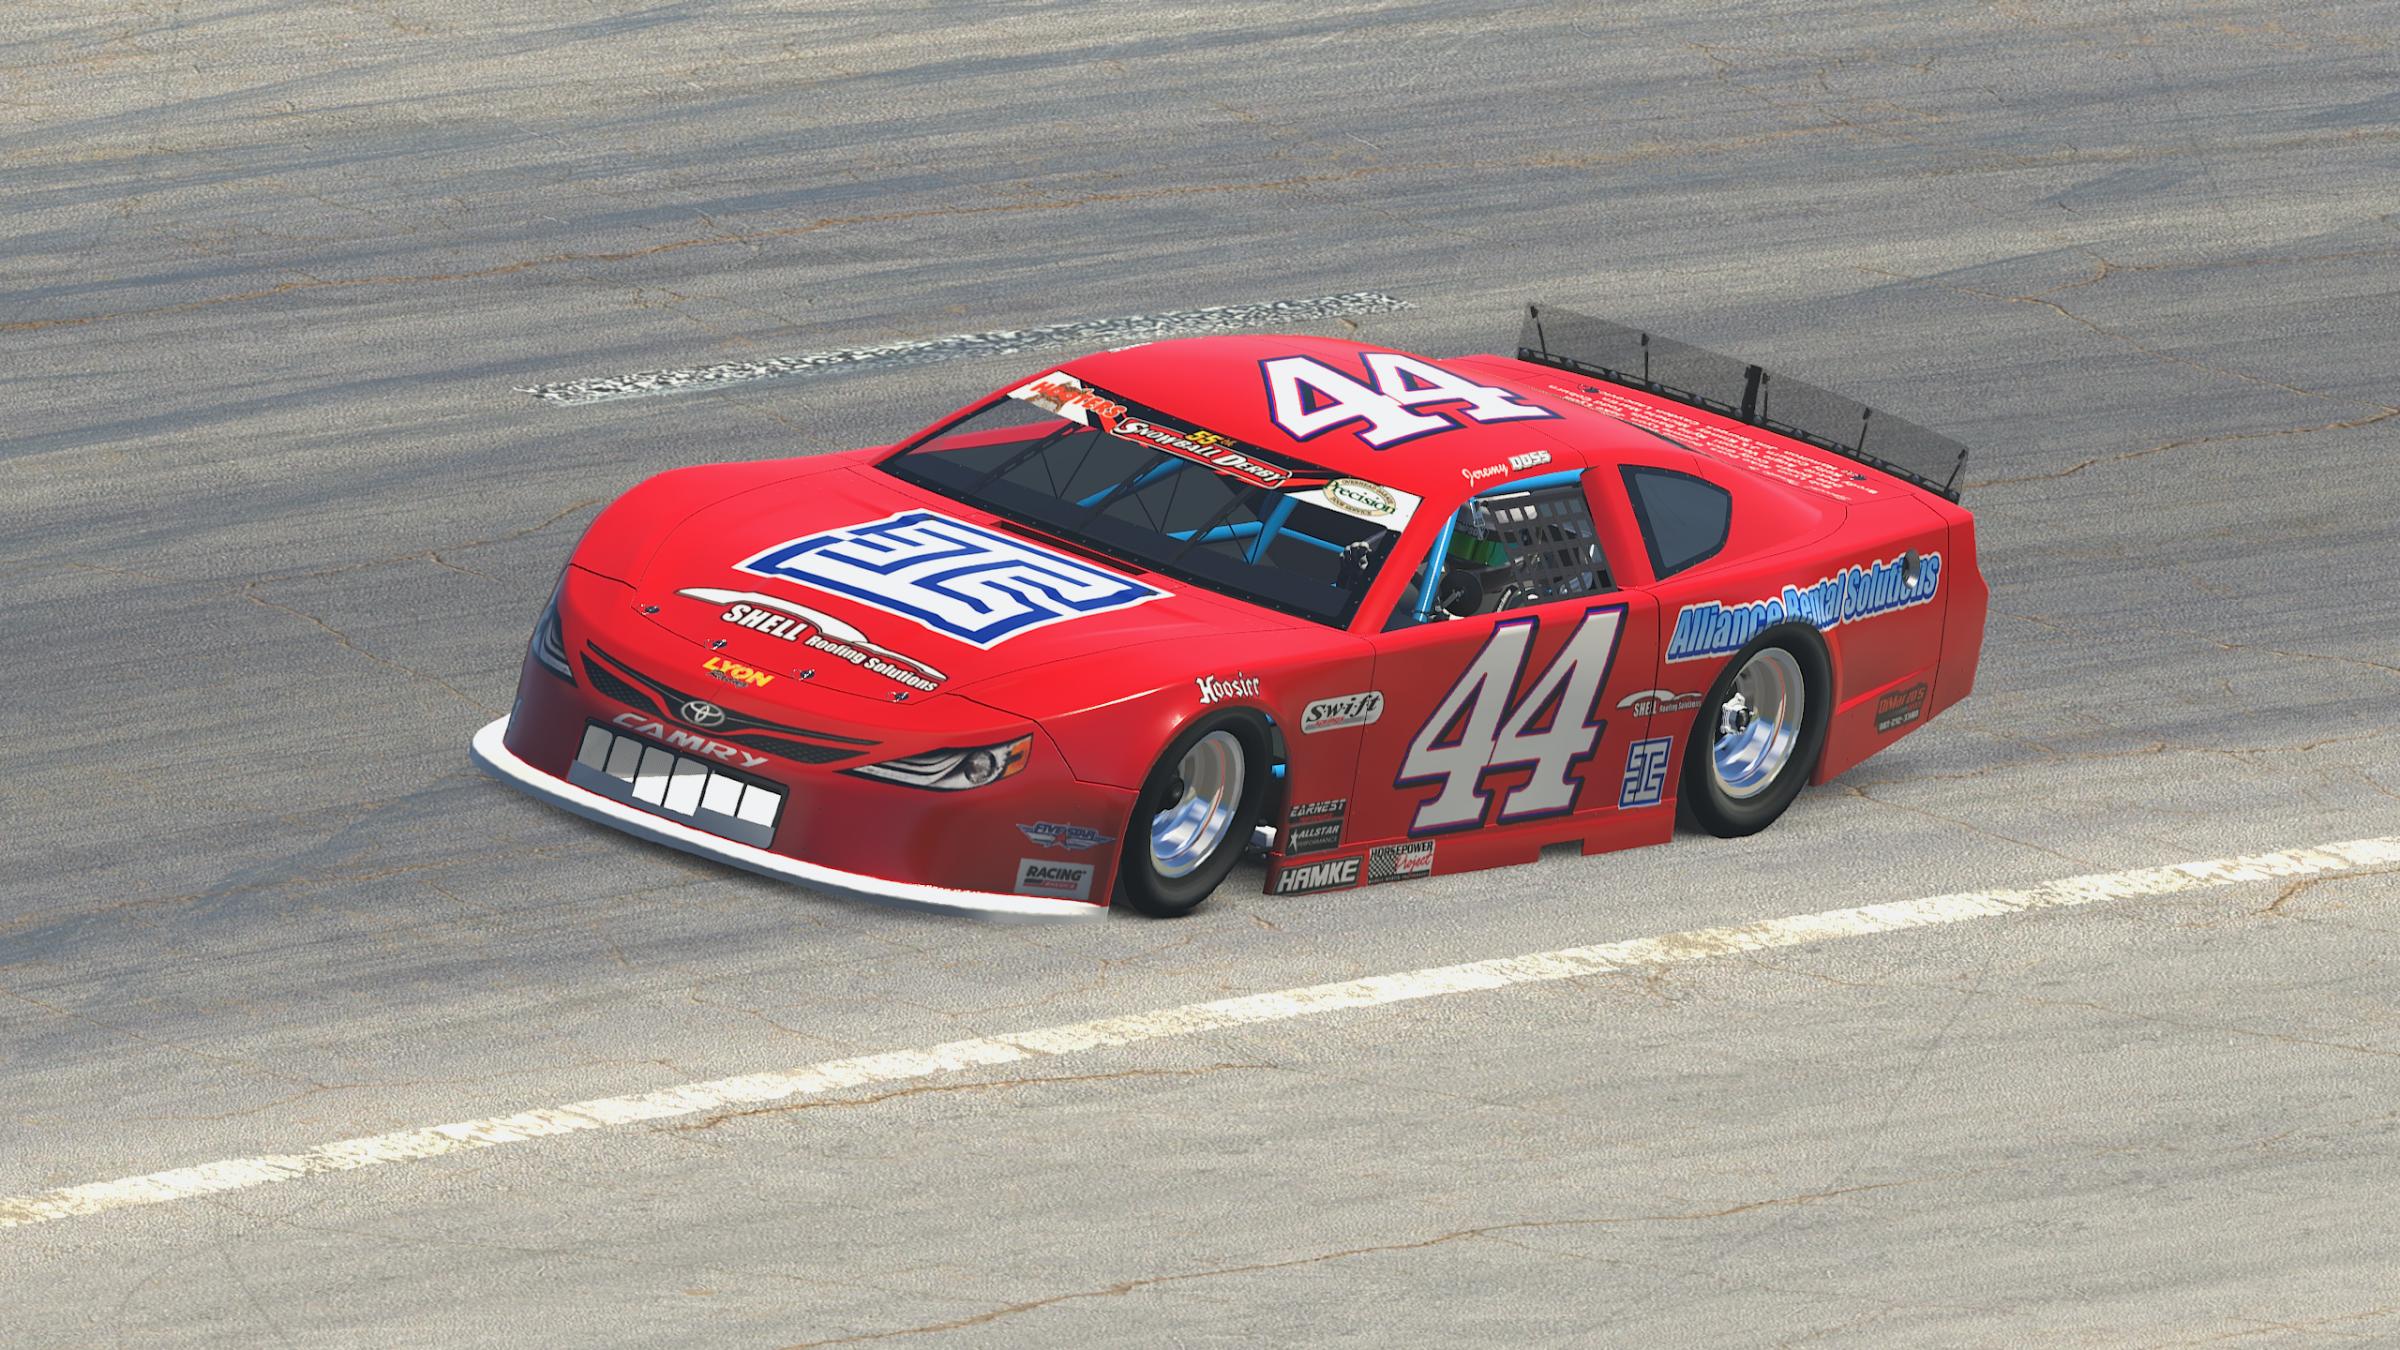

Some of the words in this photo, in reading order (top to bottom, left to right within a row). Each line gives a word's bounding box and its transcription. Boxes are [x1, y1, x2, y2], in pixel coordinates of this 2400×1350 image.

[1030, 381, 1127, 418] HOOTERS
[1258, 353, 1565, 451] 44
[1113, 421, 1214, 459] SNOWBALL
[1211, 453, 1287, 483] DERBY
[1461, 463, 1508, 488] Jeremy
[1508, 450, 1552, 472] DOSS
[1323, 480, 1396, 515] Precision
[1843, 552, 1942, 624] Solutins
[721, 603, 808, 642] SHELL
[804, 634, 868, 666] Roofing
[863, 656, 939, 693] Solutions
[702, 656, 775, 688] LYON
[1196, 672, 1260, 704] Hoosier
[1394, 602, 1629, 838] 44
[612, 712, 769, 768] CAMRY
[1289, 799, 1346, 818] EARNEST
[1298, 825, 1340, 840] ALLSTAR
[1371, 841, 1433, 858] HORSEPOWER
[1026, 866, 1082, 881] RACING
[1276, 859, 1360, 893] HAMKE
